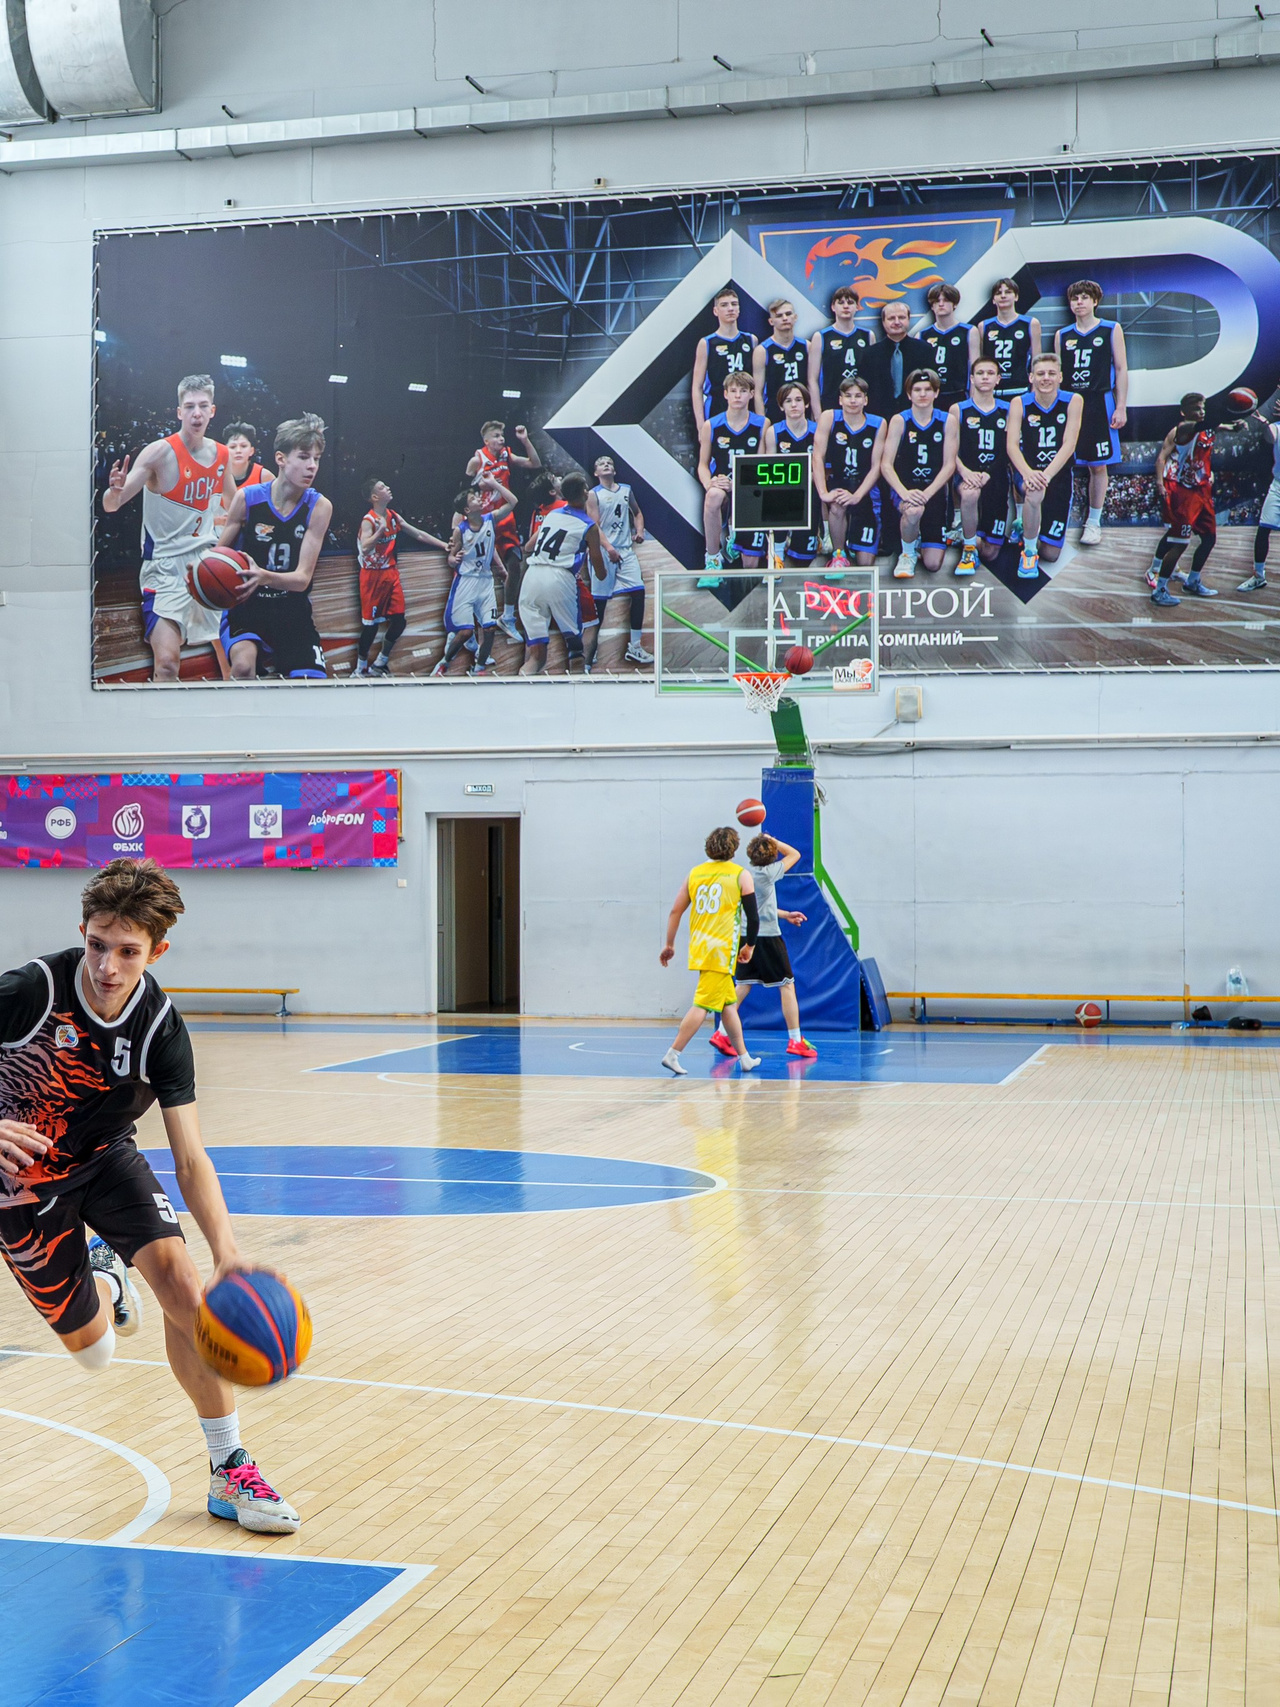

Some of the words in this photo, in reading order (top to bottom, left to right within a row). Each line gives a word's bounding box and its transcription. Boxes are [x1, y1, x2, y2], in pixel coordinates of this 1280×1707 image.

[844, 348, 856, 366] 4
[935, 346, 946, 364] 8
[995, 339, 1013, 358] 22
[1073, 348, 1092, 368] 15
[726, 352, 744, 373] 34
[784, 361, 799, 382] 23
[978, 428, 995, 450] 19
[1038, 426, 1056, 447] 12
[917, 444, 928, 464] 5
[1095, 441, 1110, 458] 15
[183, 476, 219, 503] ЦСК
[860, 527, 874, 543] 11
[991, 520, 1006, 535] 19
[1048, 520, 1065, 537] 12
[751, 531, 764, 547] 13
[266, 543, 291, 570] 13
[765, 582, 995, 621] АРХСТРОЙ
[807, 634, 869, 648] ГРУППА
[50, 819, 71, 827] РФБ
[308, 810, 365, 826] ДоброFON
[113, 843, 143, 852] ФБХК
[695, 883, 723, 914] 68
[111, 1037, 131, 1077] 5
[152, 1193, 178, 1224] 5
